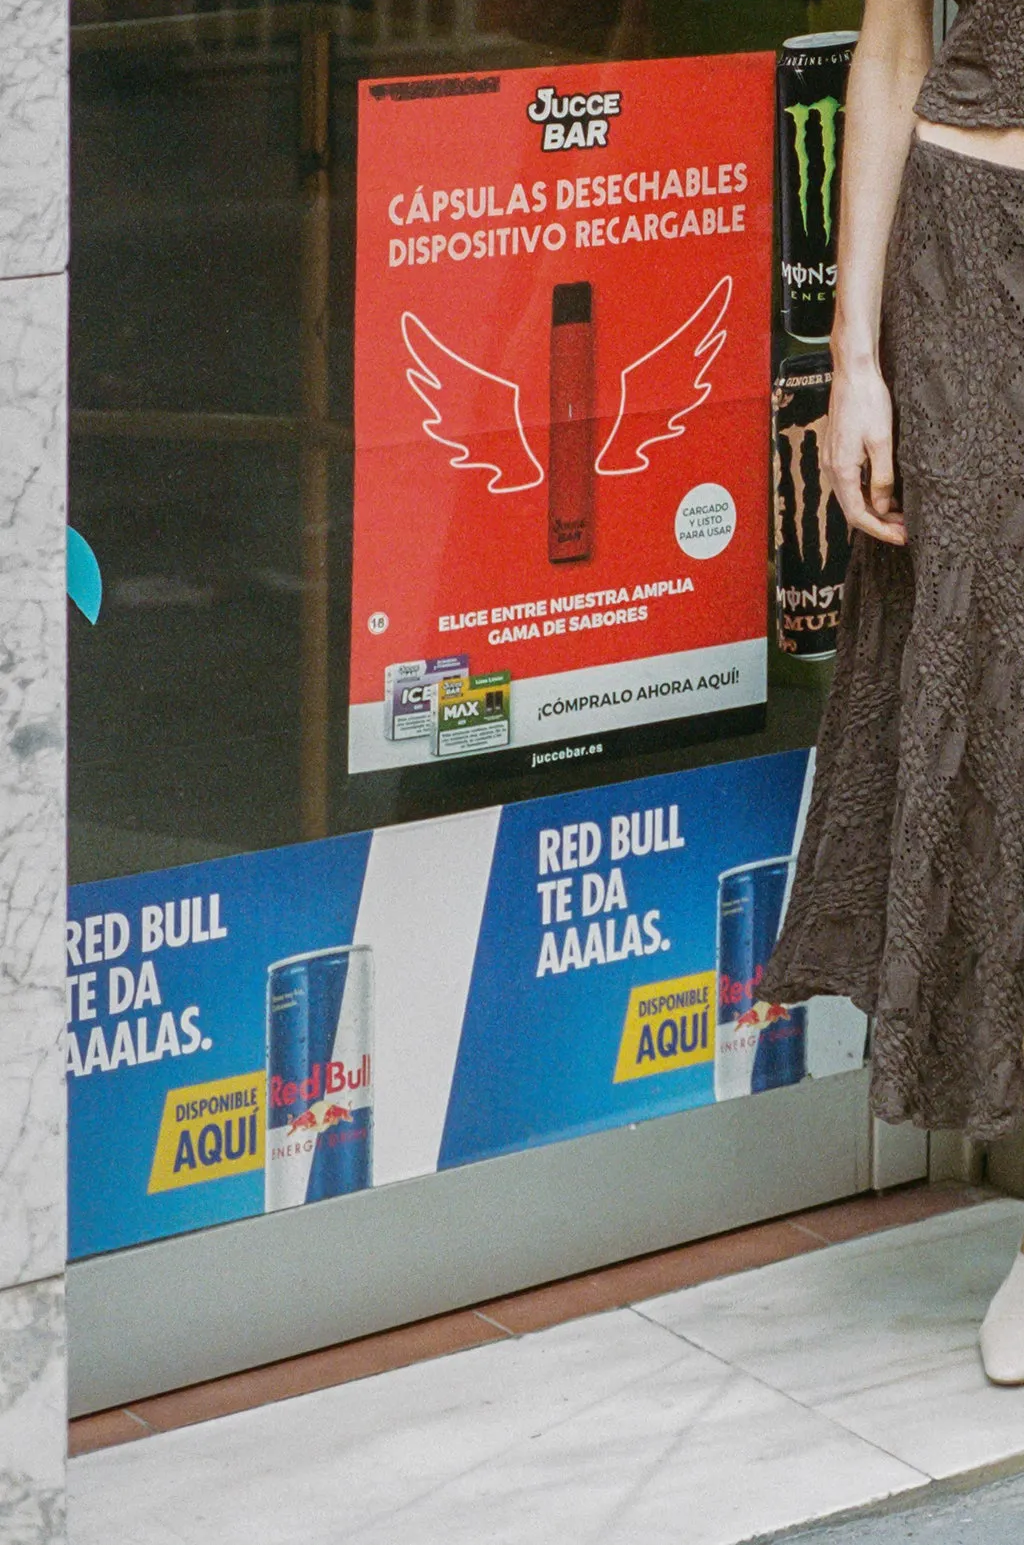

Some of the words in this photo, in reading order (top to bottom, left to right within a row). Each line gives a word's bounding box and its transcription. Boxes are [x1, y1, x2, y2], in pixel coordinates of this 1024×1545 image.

[543, 120, 608, 151] BAR
[387, 181, 547, 226] CÁPSULAS
[557, 162, 748, 211] DESECHABLES
[389, 223, 566, 268] DISPOSITIVO
[575, 204, 746, 249] RECARGABLE
[786, 374, 823, 387] GINGER
[679, 530, 705, 540] PARA
[707, 525, 732, 537] USAR
[682, 502, 728, 517] CARGADO
[689, 519, 695, 527] Y
[697, 515, 723, 527] LISTO
[371, 617, 386, 630] 18
[438, 610, 487, 632] ELIGE
[491, 603, 547, 624] ENTRE
[550, 589, 629, 615] NUESTRA
[632, 577, 695, 602] AMPLIA
[488, 626, 540, 646] GAMA
[543, 619, 566, 638] DE
[568, 606, 648, 633] SABORES
[444, 701, 479, 721] MAX
[537, 690, 633, 722] ¡CÓMPRALO
[636, 679, 695, 702] AHORA
[696, 667, 740, 692] AQUÍ!
[531, 742, 604, 768] juccebar.es
[539, 820, 601, 875] RED
[610, 805, 685, 860] BULL
[141, 893, 227, 953] BULL
[537, 880, 572, 925] TE
[582, 868, 628, 917] DA
[536, 910, 670, 978] AAALAS.
[109, 960, 161, 1015] DA
[639, 986, 709, 1017] DISPONIBLE
[66, 1006, 213, 1077] AAALAS.
[636, 1006, 709, 1064] AQUÍ
[175, 1088, 257, 1123] DISPONIBLE
[270, 1063, 320, 1108] Red
[326, 1054, 371, 1094] Bull
[173, 1107, 258, 1173] AQUÍ
